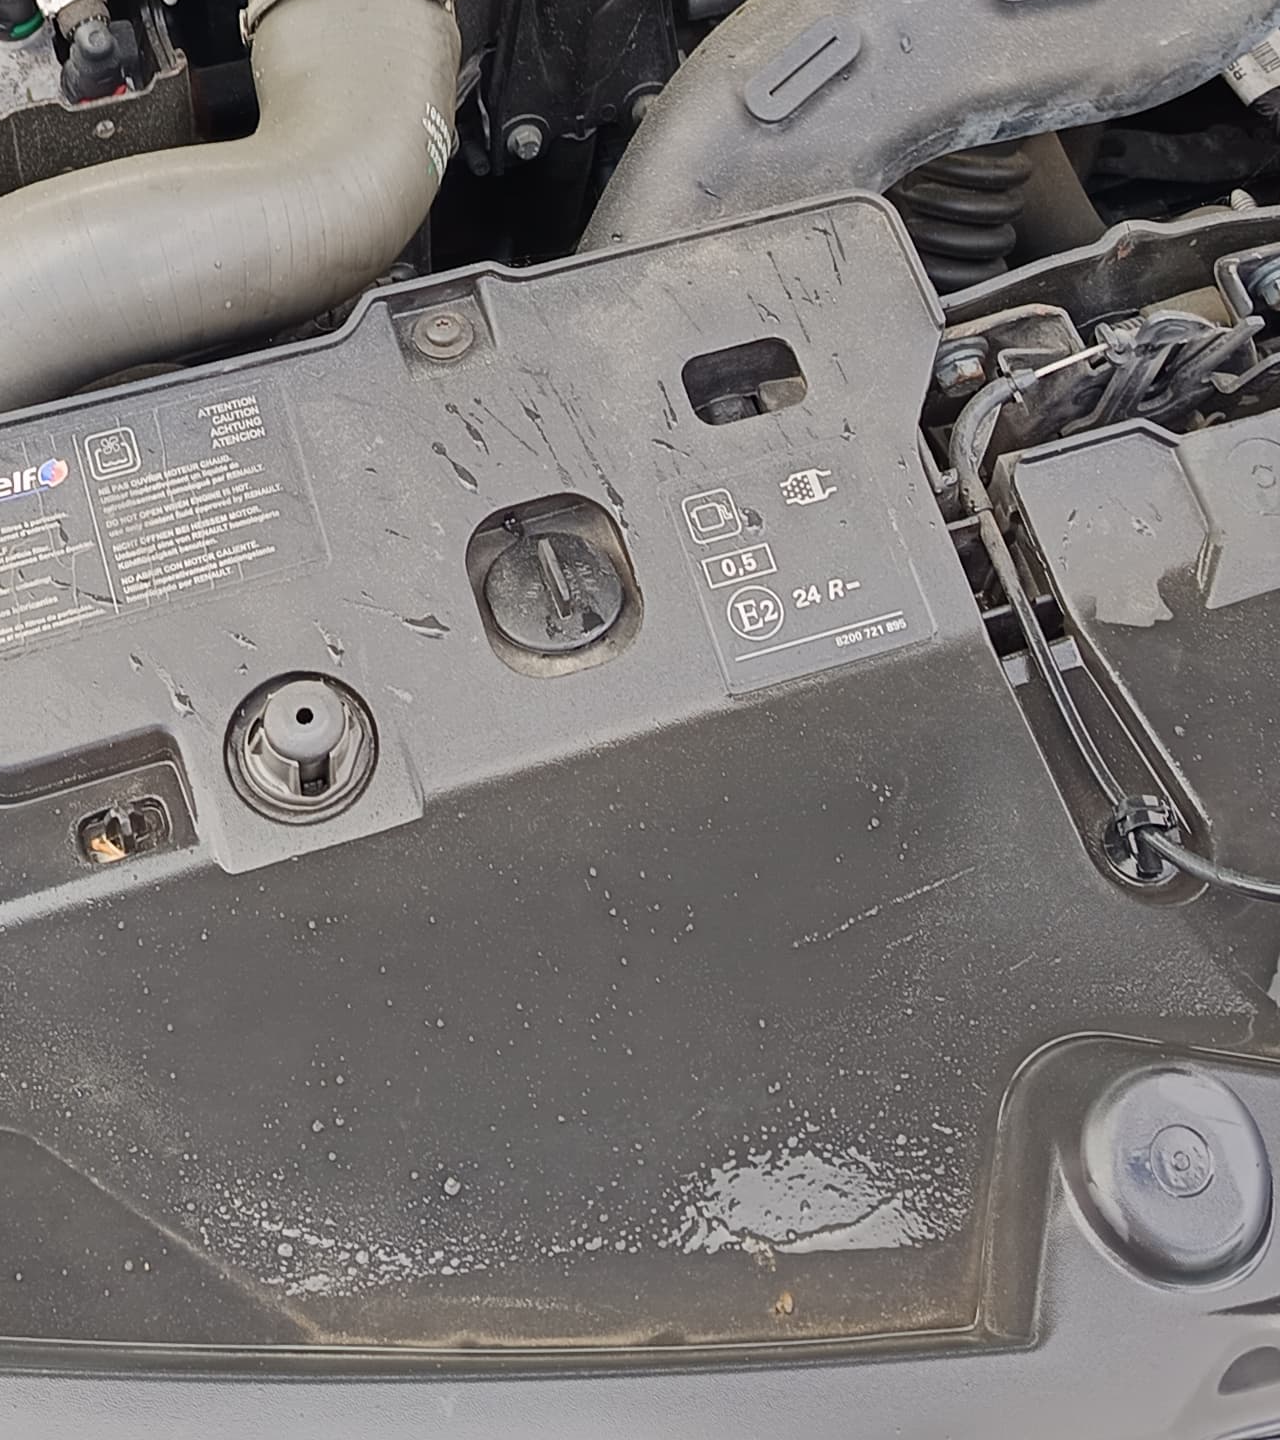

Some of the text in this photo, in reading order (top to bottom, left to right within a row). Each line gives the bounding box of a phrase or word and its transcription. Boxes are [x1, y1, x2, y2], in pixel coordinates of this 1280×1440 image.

[197, 397, 257, 418] ATTENTION
[213, 407, 260, 425] CAUTION
[210, 417, 263, 437] ACHTUNG
[211, 427, 266, 448] ATENCION
[721, 553, 757, 577] 0,5
[734, 600, 779, 632] E2
[793, 587, 822, 609] 24
[835, 633, 862, 648] 8200
[863, 627, 885, 642] 721
